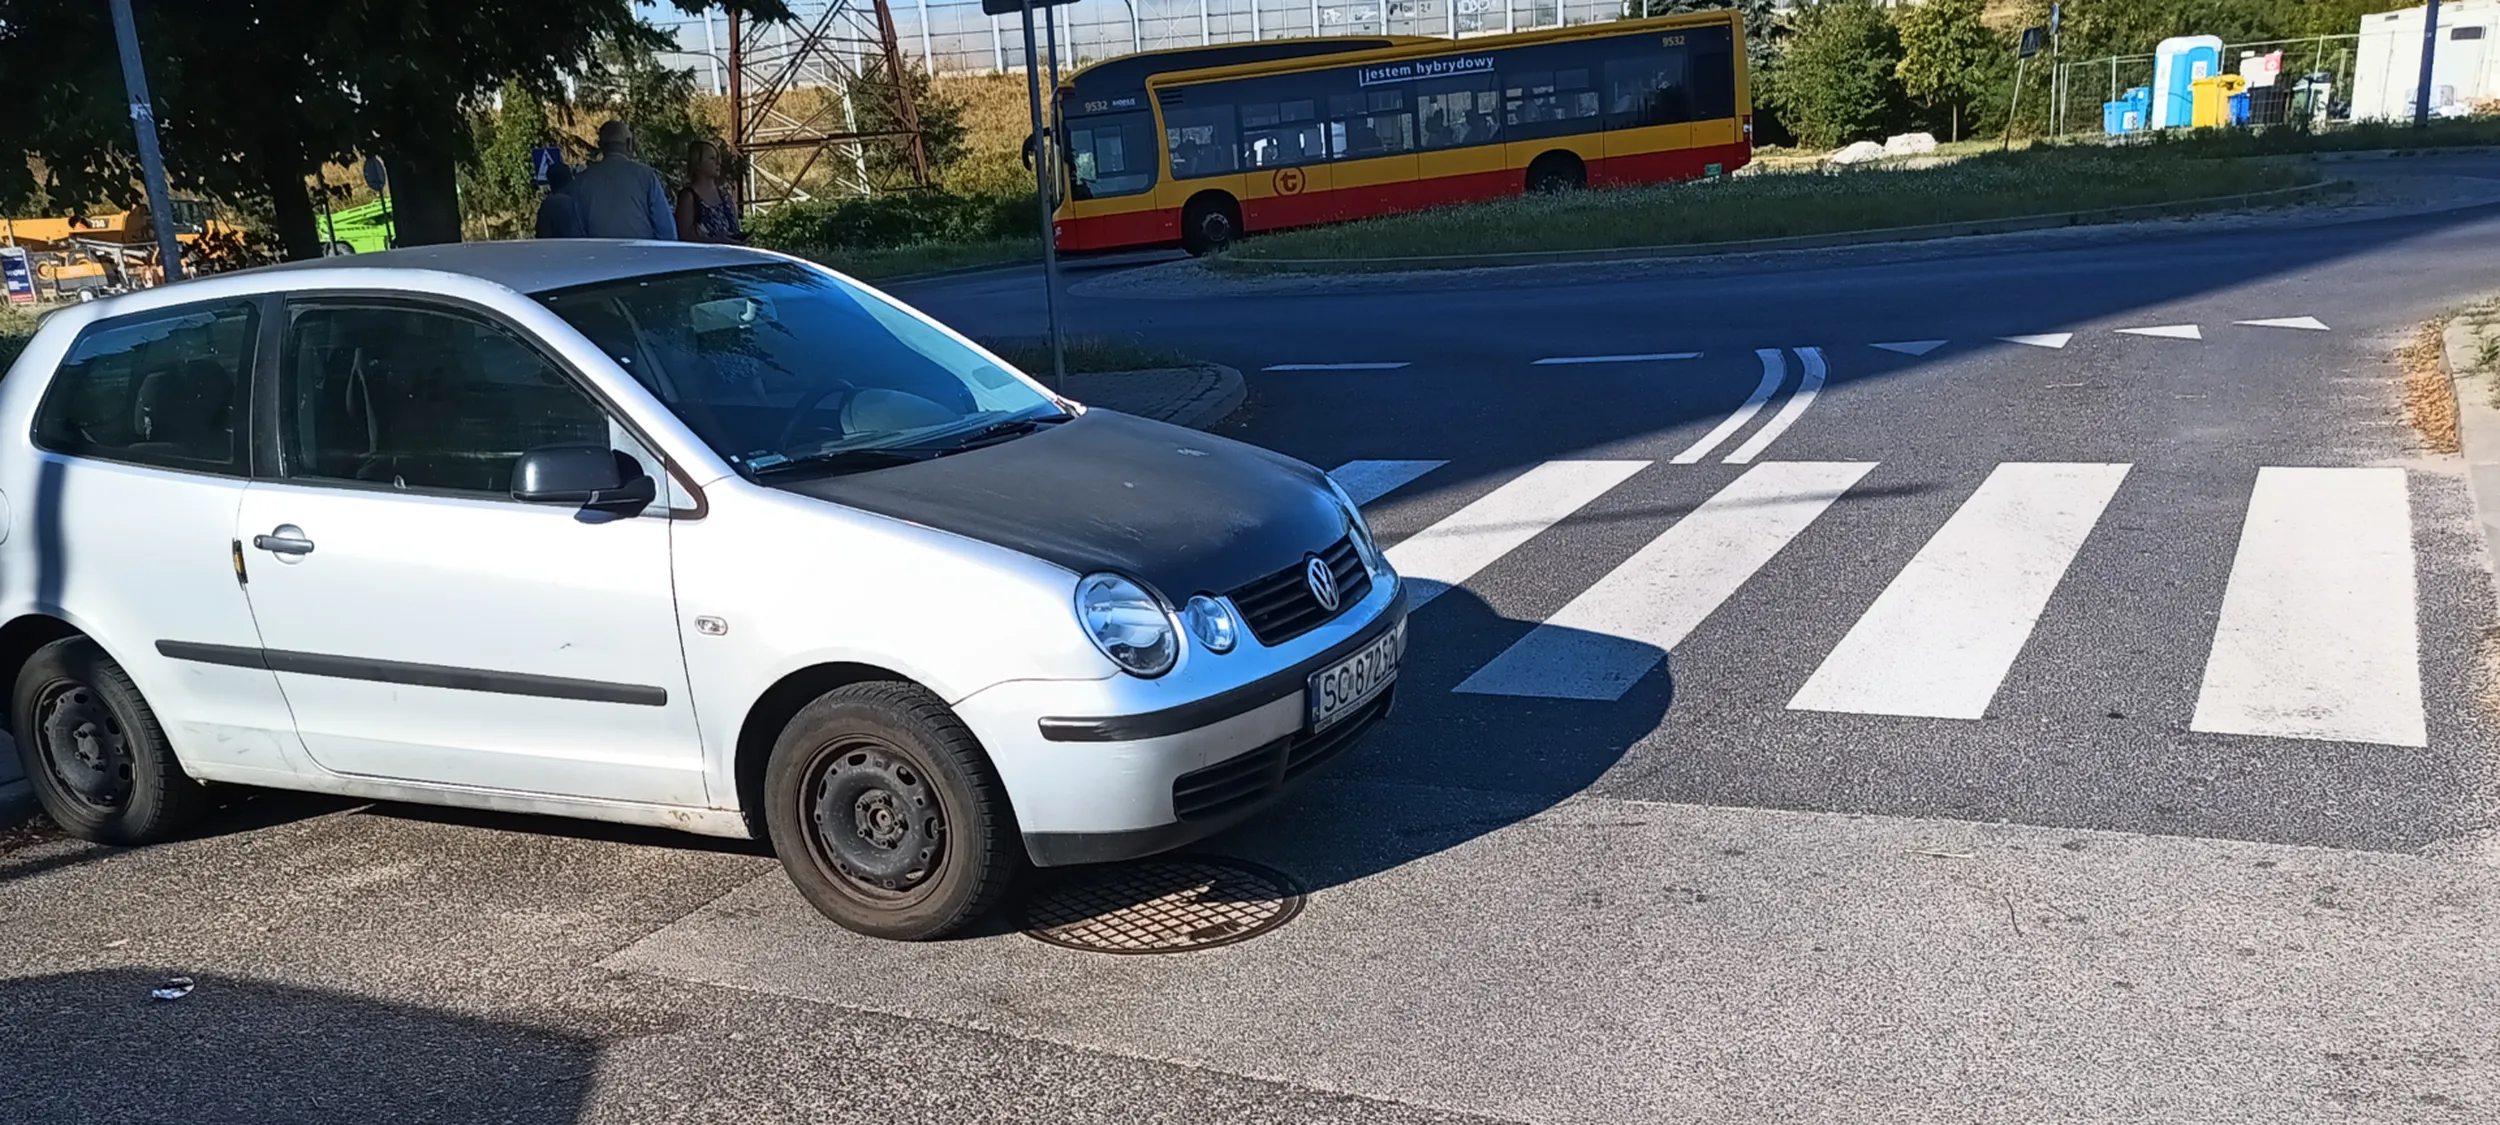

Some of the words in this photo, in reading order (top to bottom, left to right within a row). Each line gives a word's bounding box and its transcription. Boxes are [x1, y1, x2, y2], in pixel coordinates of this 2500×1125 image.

[1662, 35, 1686, 48] 9532
[1365, 65, 1411, 82] jestem
[1416, 57, 1495, 76] hybrydowy
[1084, 100, 1108, 112] 9532
[1324, 667, 1350, 713] SC
[1356, 634, 1396, 695] 87252
